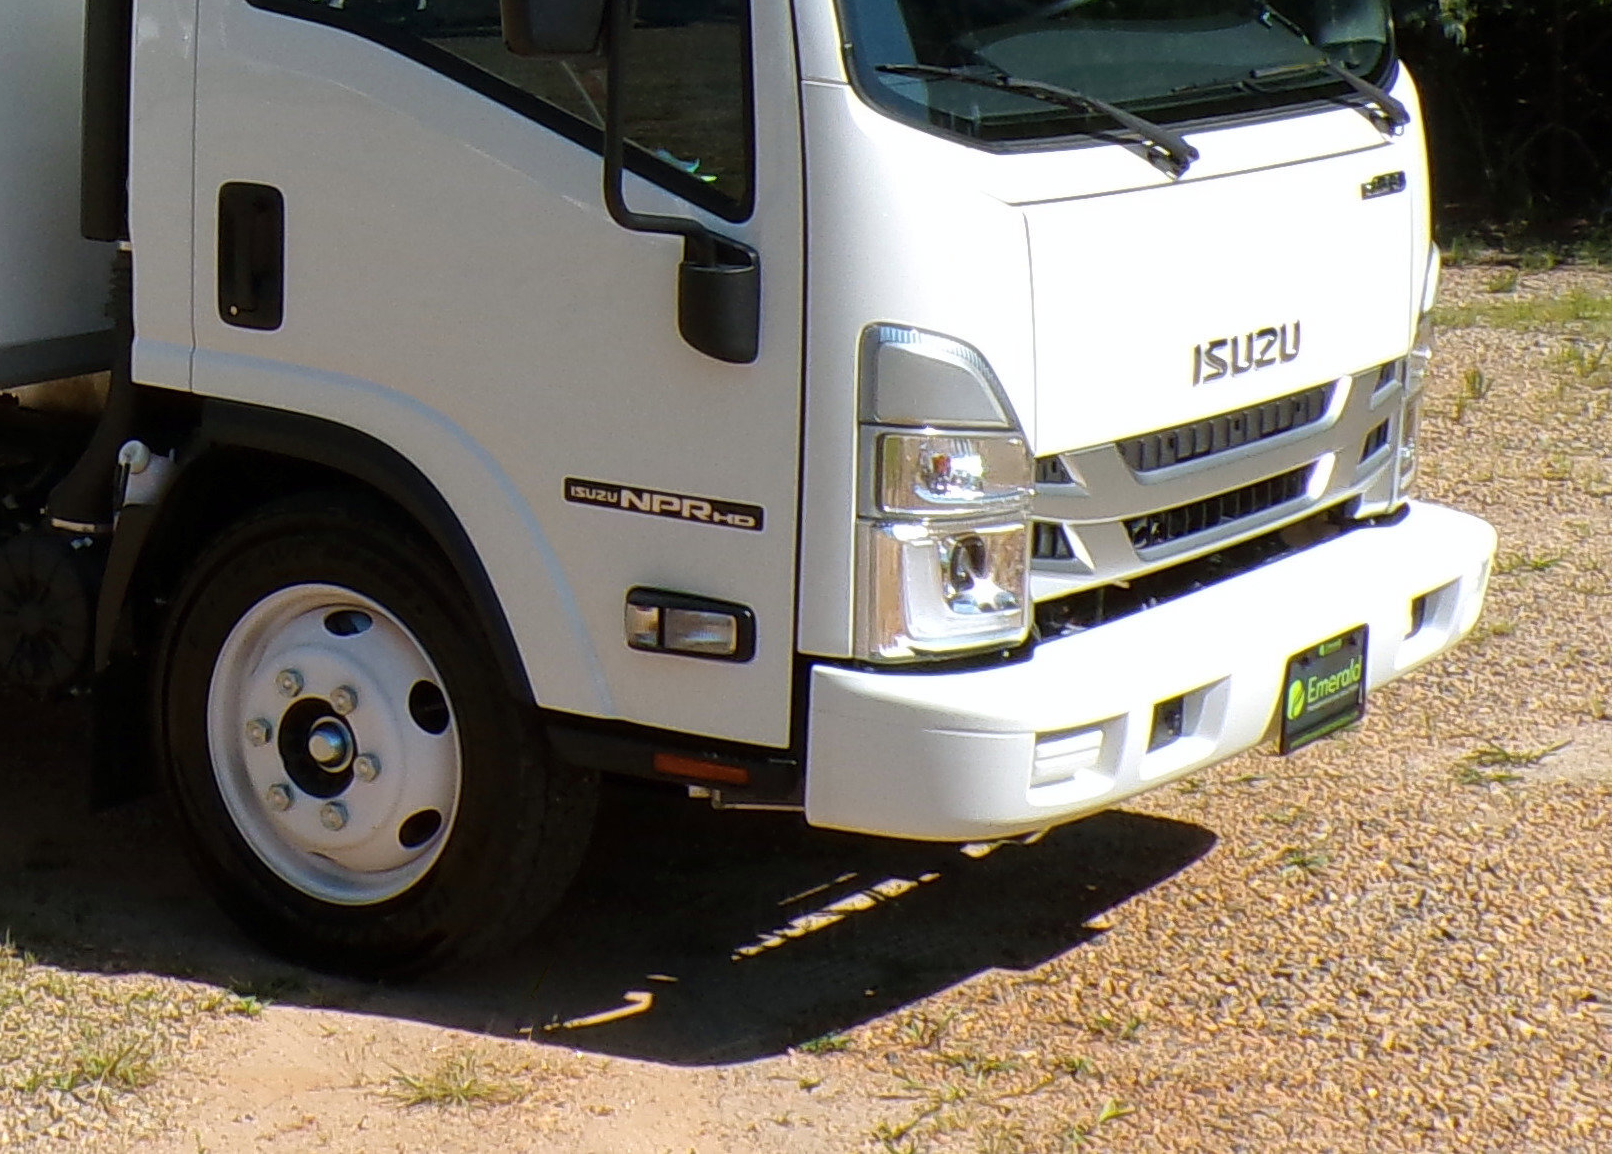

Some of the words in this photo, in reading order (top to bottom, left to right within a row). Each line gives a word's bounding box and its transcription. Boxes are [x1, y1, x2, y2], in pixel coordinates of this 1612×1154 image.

[1193, 319, 1300, 387] ISUZU
[570, 485, 618, 503] ISUZU
[1307, 655, 1363, 704] Emerald
